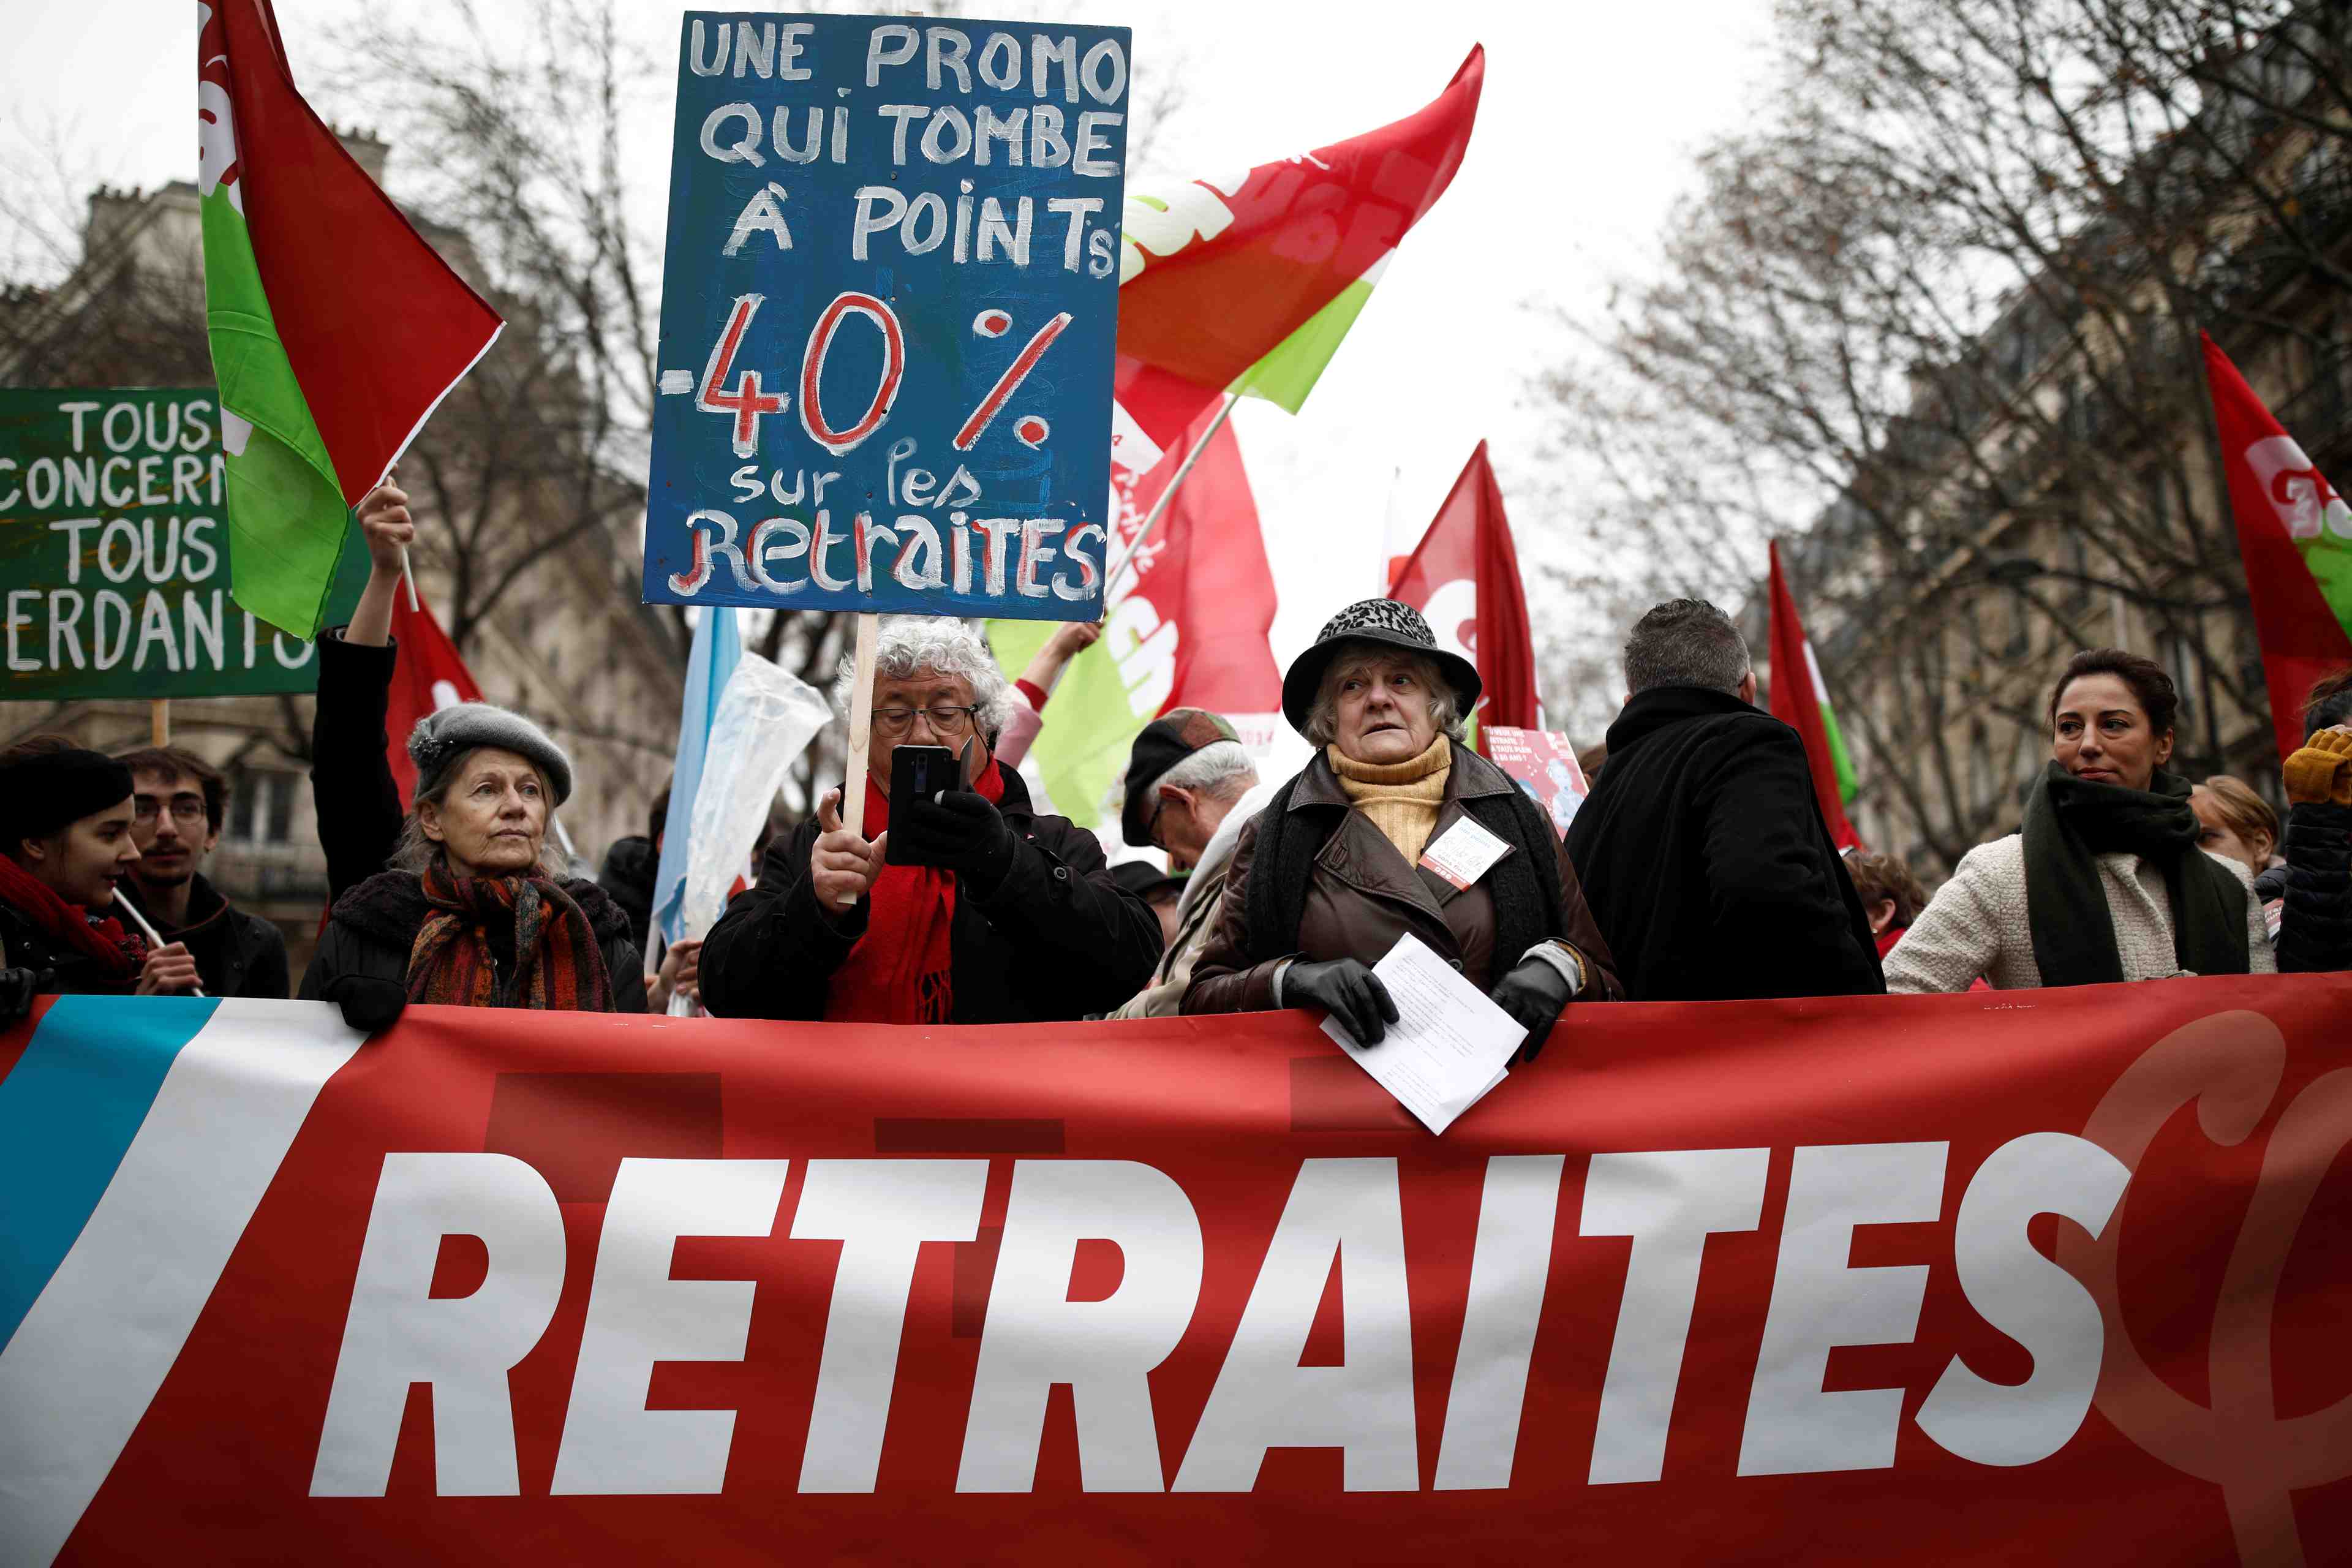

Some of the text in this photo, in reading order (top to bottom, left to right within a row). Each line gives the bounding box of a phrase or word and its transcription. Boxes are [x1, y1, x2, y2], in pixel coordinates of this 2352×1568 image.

[691, 20, 1126, 105] UNE PROMO
[878, 105, 1124, 176] TOMBE
[952, 309, 1074, 451] %
[59, 399, 213, 453] TOUS
[729, 436, 982, 509] sur les
[49, 516, 218, 584] TOUS
[308, 1132, 2133, 1497] RETRAITES
